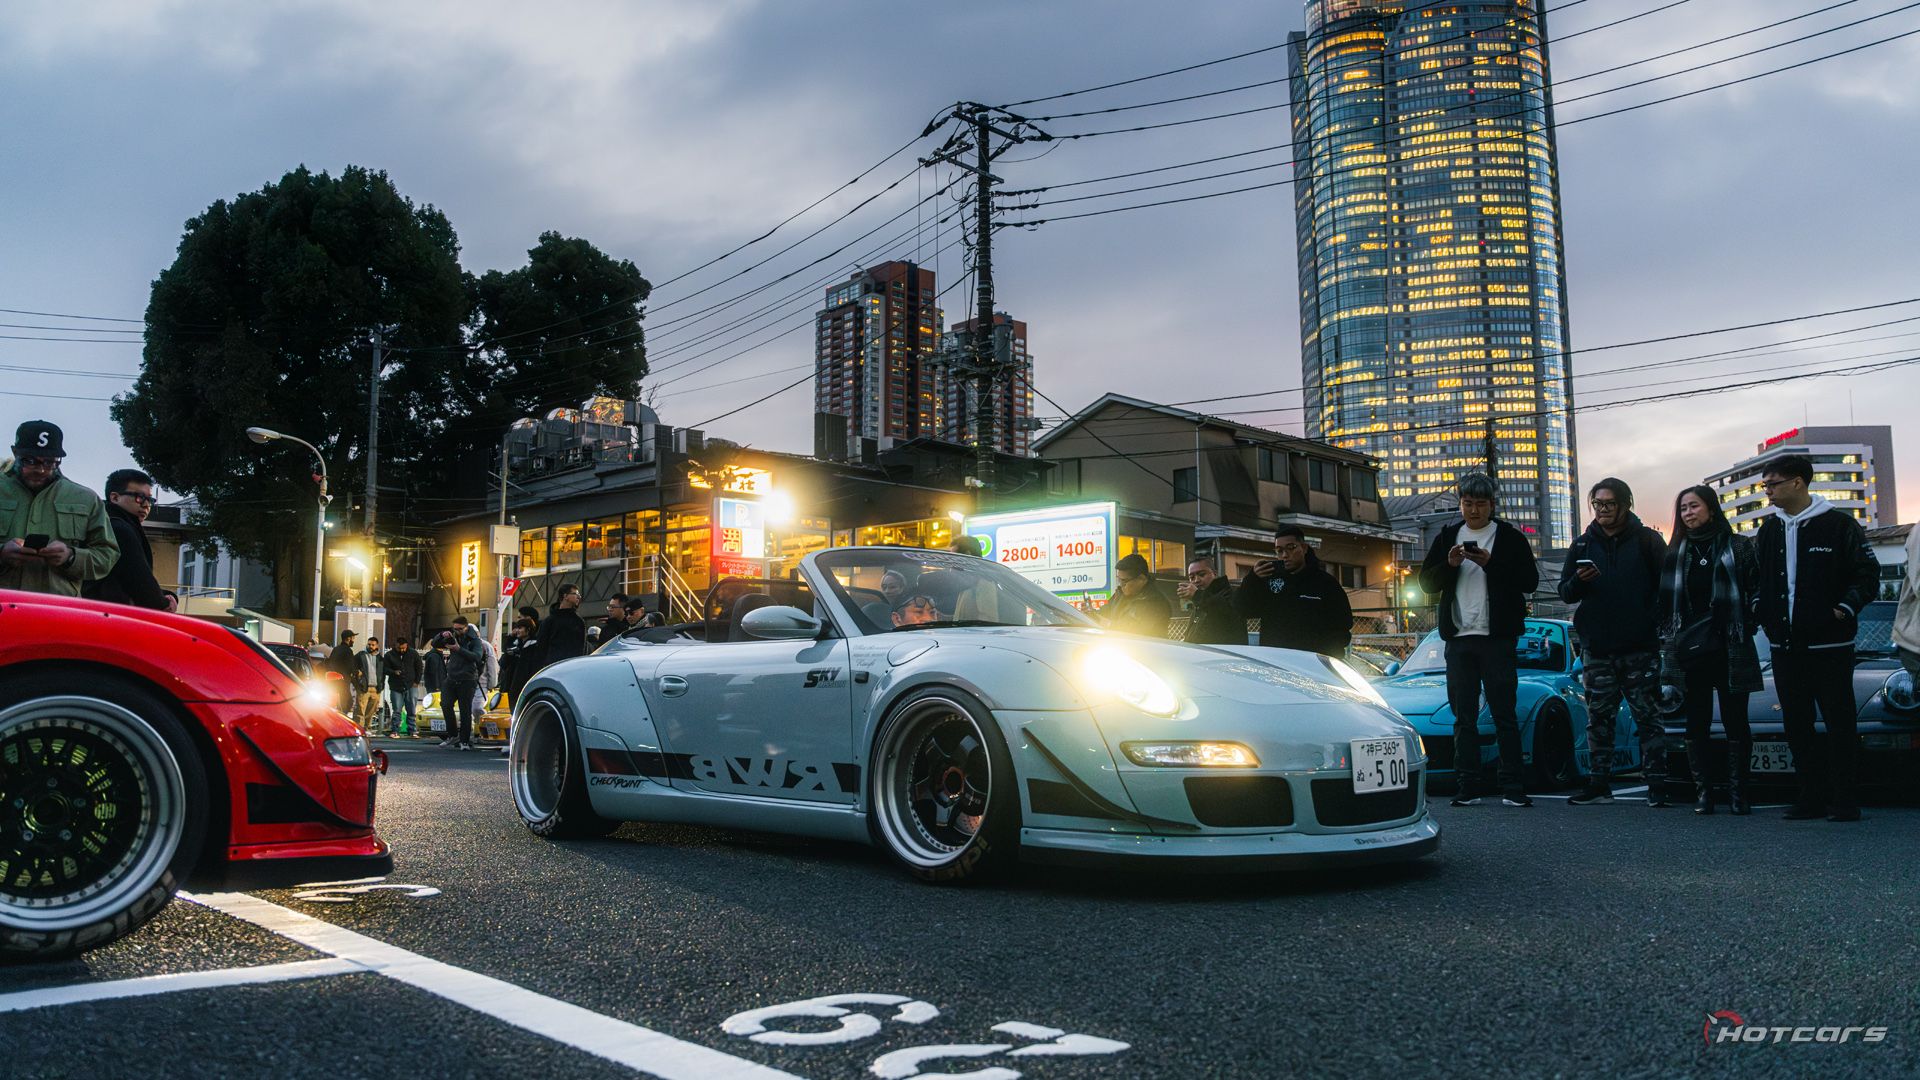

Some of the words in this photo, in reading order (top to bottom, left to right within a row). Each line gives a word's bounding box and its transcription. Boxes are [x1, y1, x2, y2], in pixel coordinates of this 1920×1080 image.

[37, 432, 49, 447] S
[722, 529, 740, 553] 満
[504, 581, 514, 594] P
